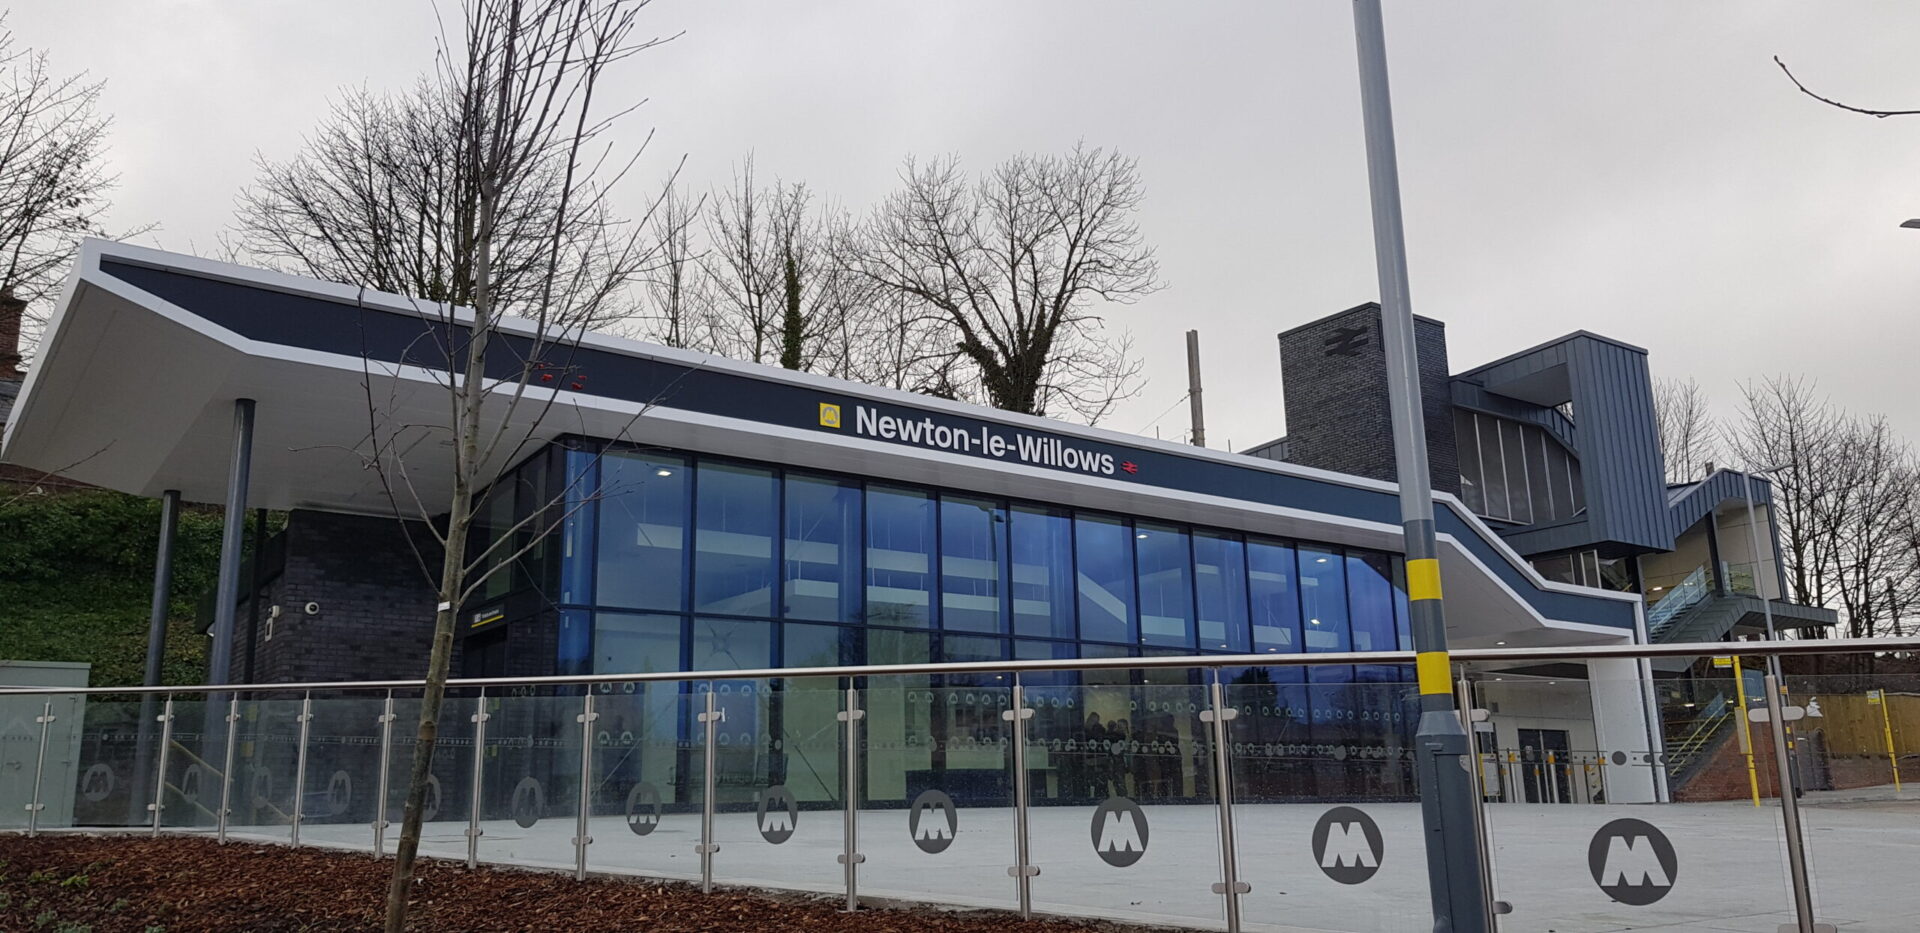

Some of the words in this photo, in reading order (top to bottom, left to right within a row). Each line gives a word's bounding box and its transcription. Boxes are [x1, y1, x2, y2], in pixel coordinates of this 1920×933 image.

[856, 405, 1115, 475] Newton-le-Willows
[1098, 810, 1144, 851] M
[1321, 821, 1378, 867] M
[1601, 835, 1671, 886] M
